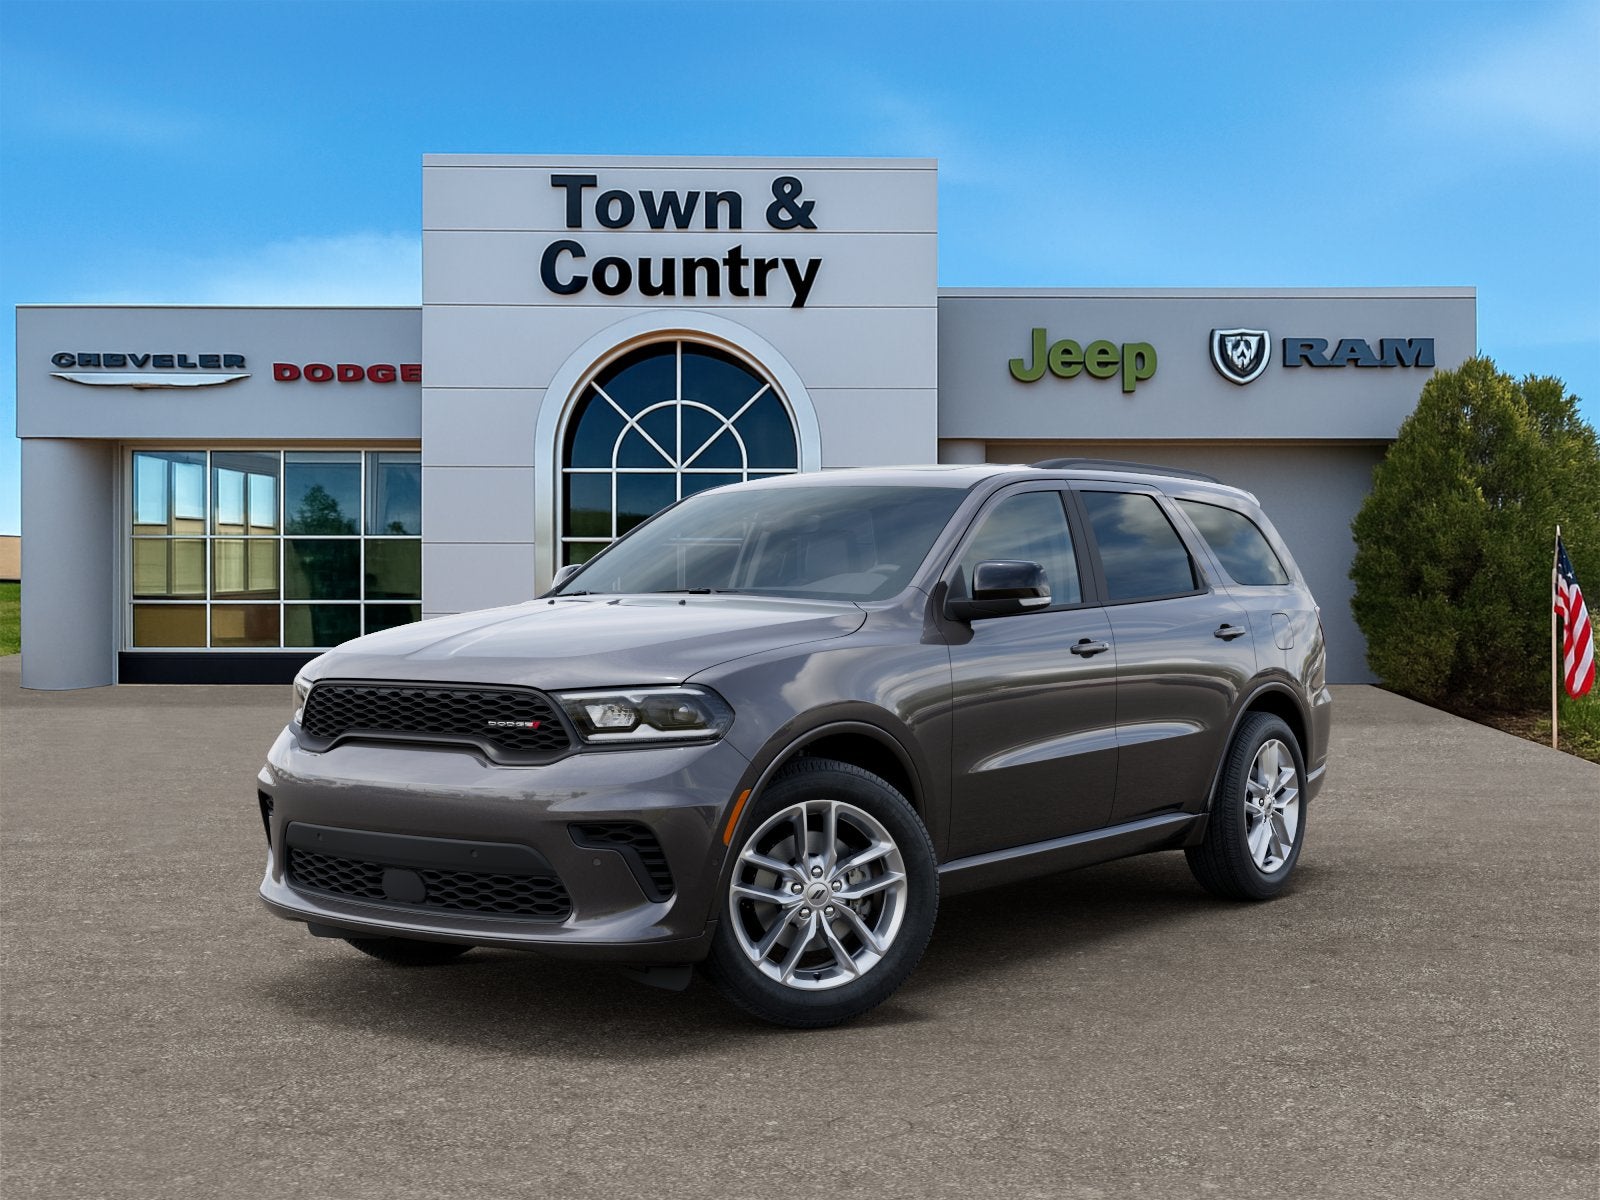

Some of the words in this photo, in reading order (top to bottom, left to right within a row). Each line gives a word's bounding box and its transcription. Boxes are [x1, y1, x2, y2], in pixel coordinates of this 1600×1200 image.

[550, 174, 743, 230] Town
[766, 176, 818, 230] &
[540, 240, 822, 308] Country
[273, 363, 422, 383] DODGE
[1009, 328, 1158, 393] Jeep
[1283, 338, 1435, 368] RAM
